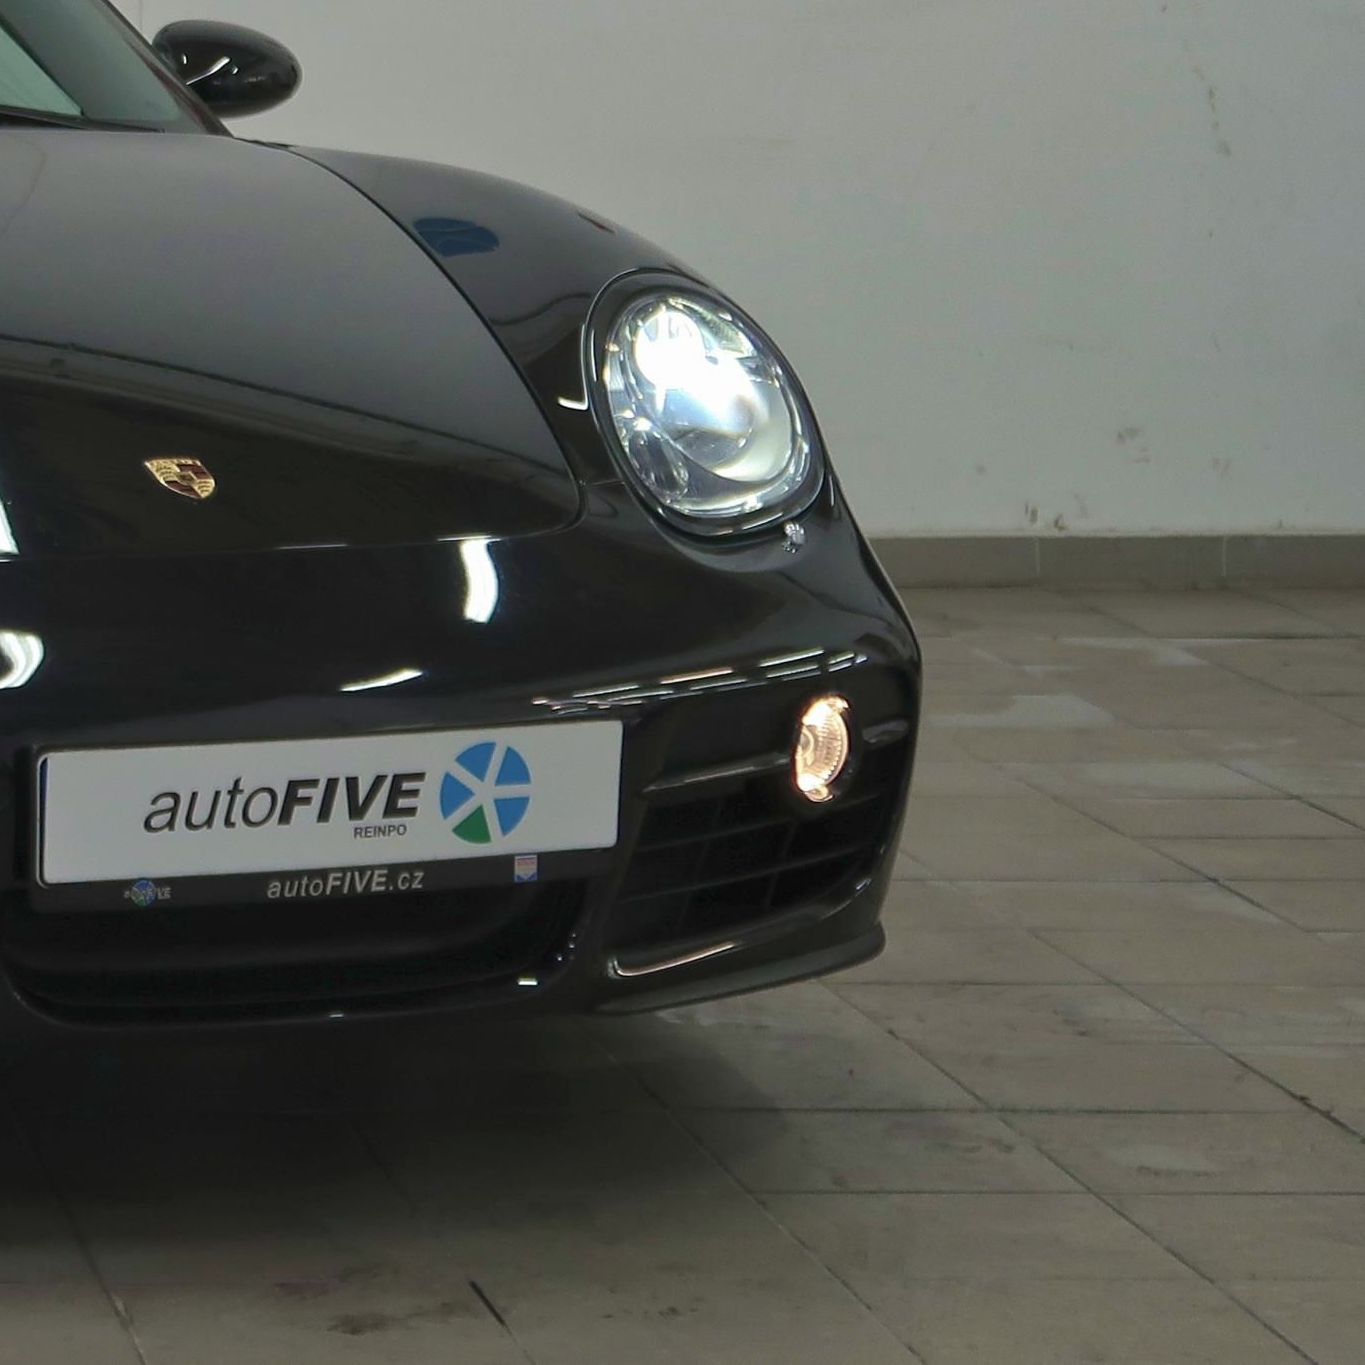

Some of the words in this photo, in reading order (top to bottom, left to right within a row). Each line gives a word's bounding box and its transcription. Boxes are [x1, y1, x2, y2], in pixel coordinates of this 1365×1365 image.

[143, 771, 427, 834] autoFIVE
[353, 824, 408, 840] REINPO
[267, 868, 425, 899] autoFIVE.cz
